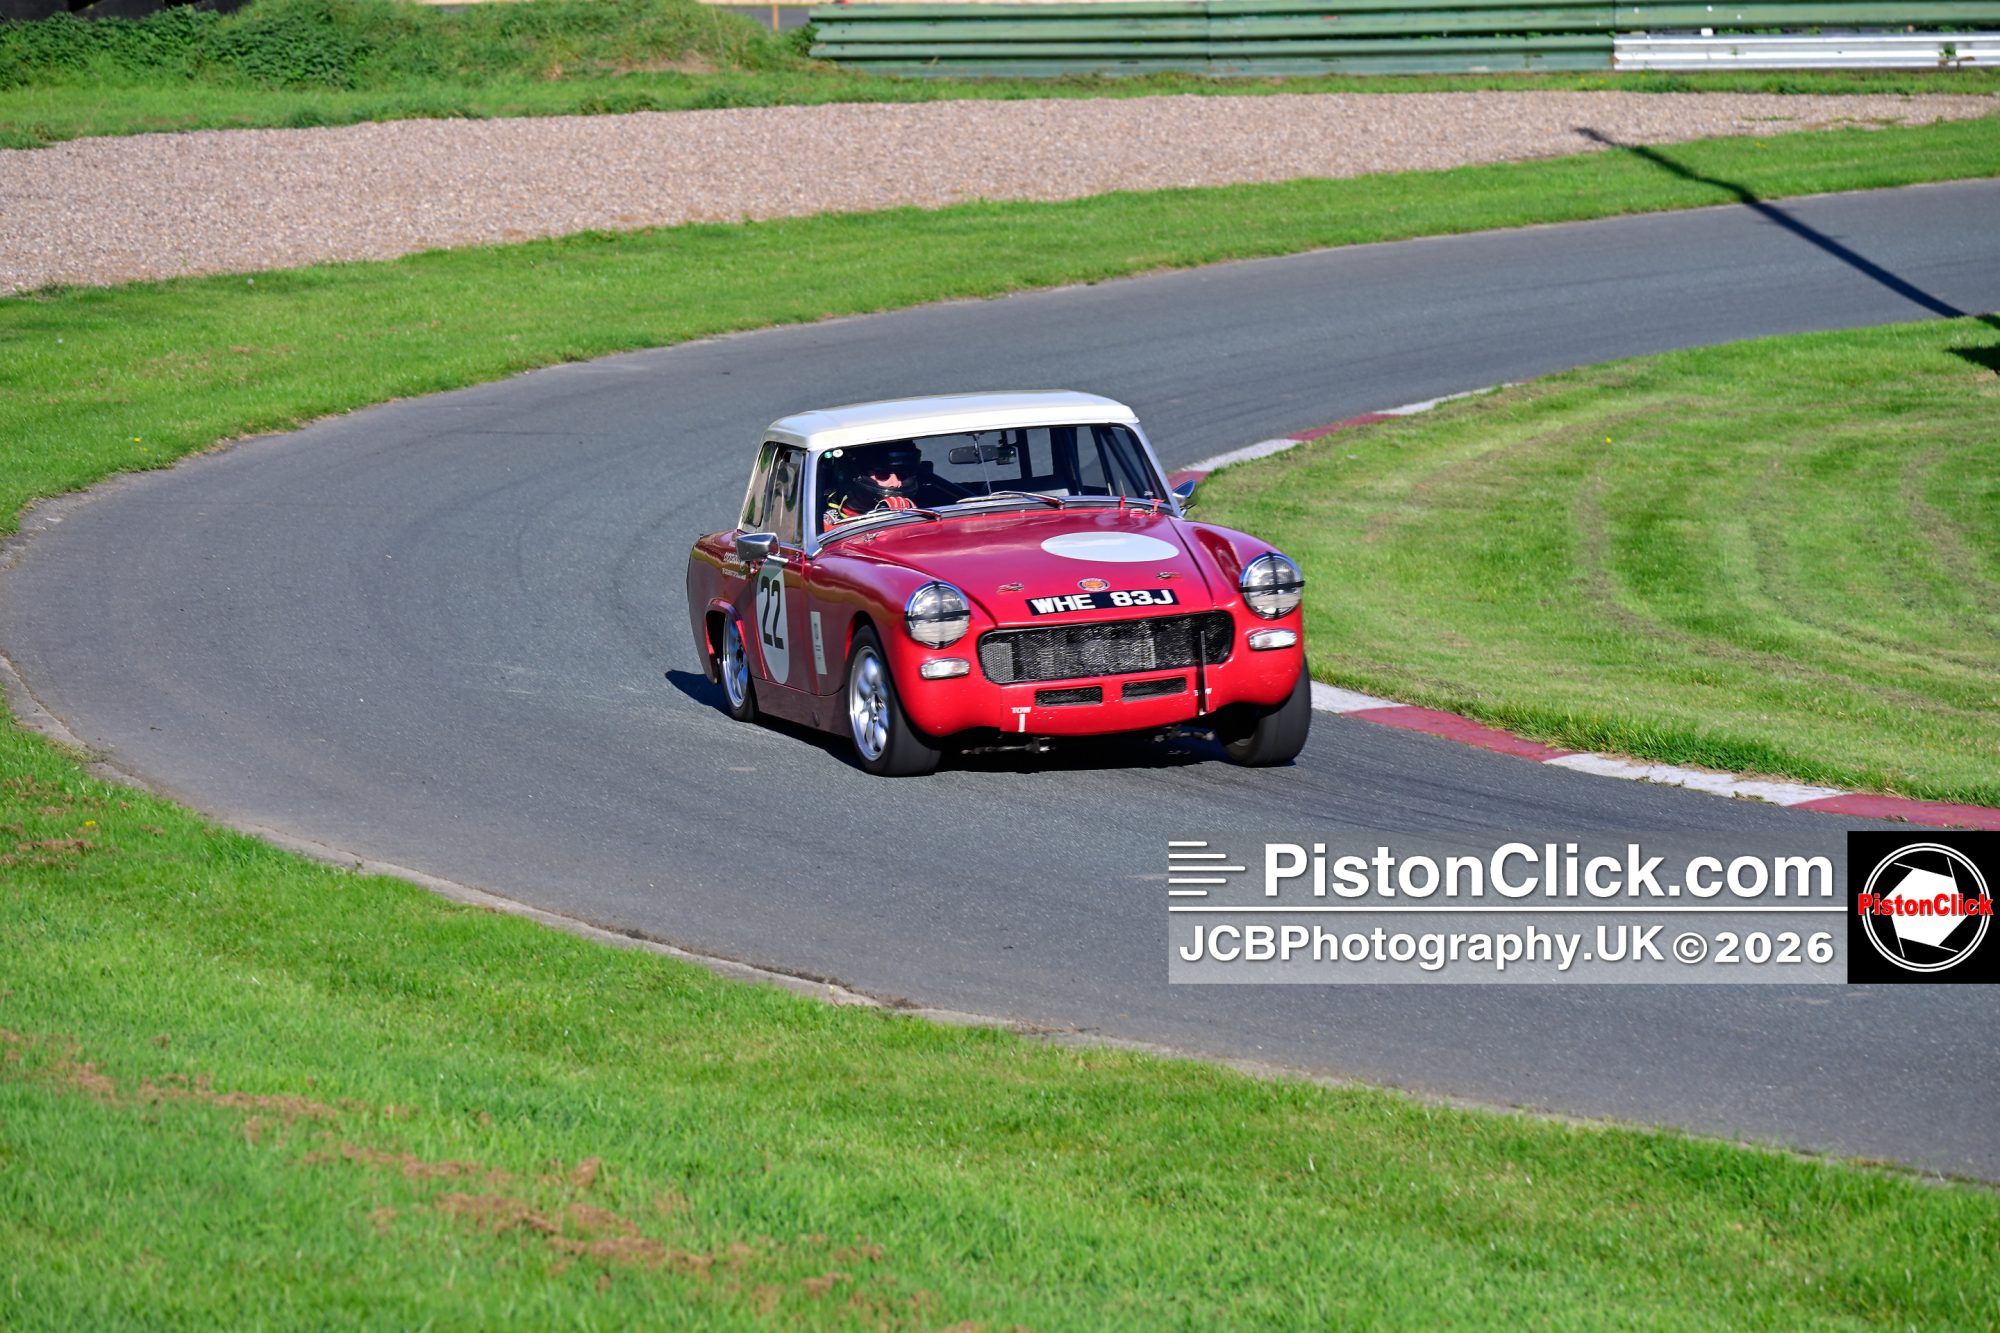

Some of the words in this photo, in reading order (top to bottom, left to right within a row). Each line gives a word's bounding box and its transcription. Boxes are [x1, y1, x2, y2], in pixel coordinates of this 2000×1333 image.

[761, 576, 784, 650] 22
[1031, 594, 1096, 614] WHE
[1109, 589, 1174, 607] 83J
[1010, 706, 1032, 714] TOW
